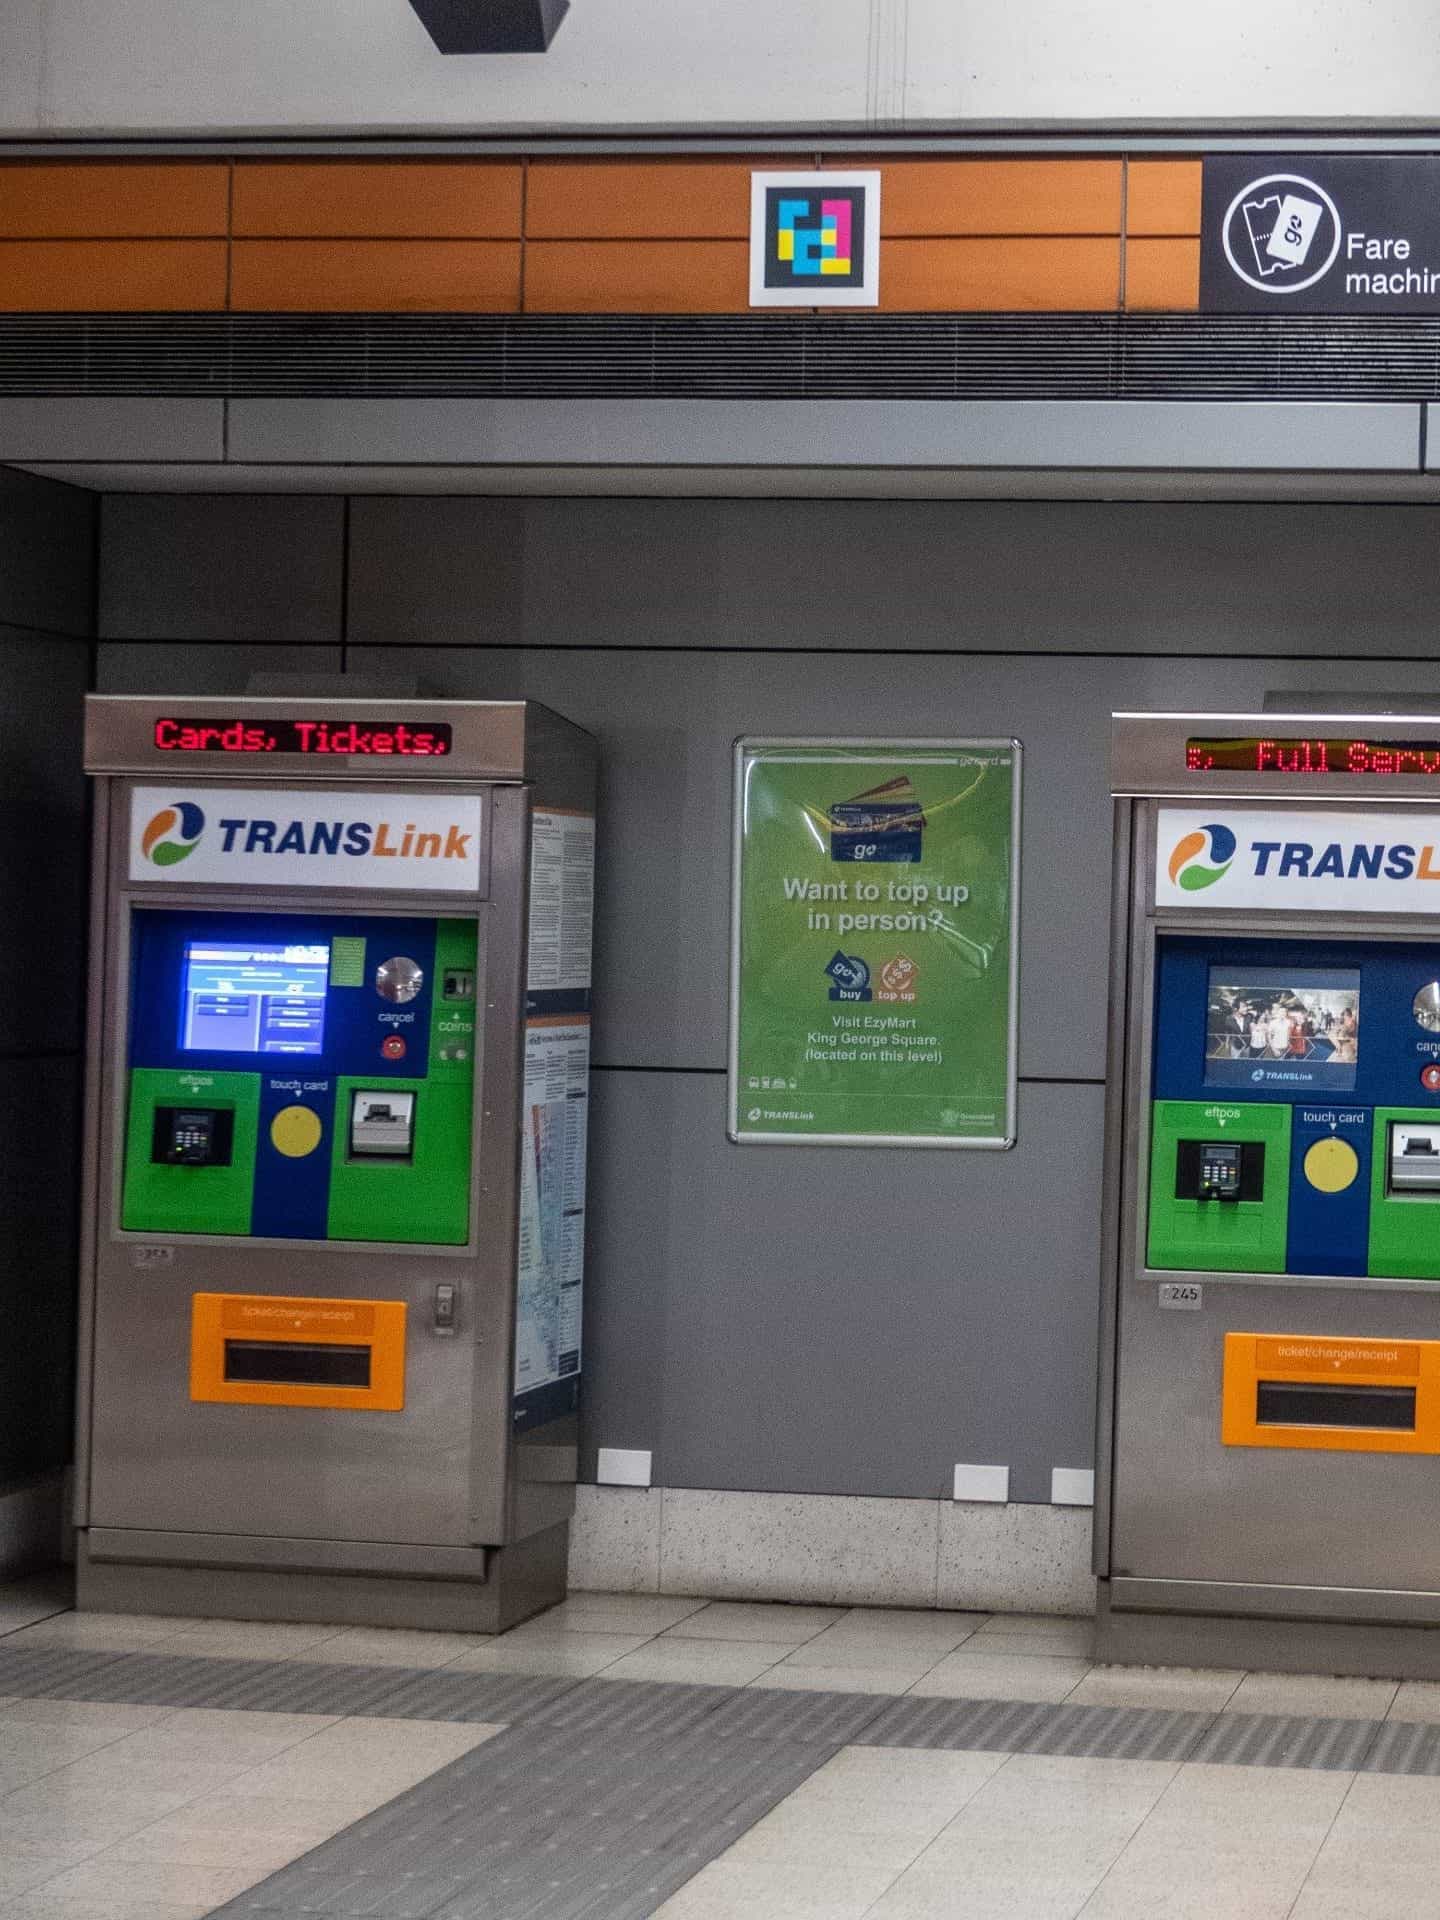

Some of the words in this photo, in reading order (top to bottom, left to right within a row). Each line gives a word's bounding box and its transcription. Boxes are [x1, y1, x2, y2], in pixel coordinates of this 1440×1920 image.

[1347, 233, 1410, 260] Fare
[1345, 267, 1440, 294] machin
[155, 719, 277, 751] Cards,
[294, 723, 447, 754] Tickets,
[1256, 741, 1329, 772] Full
[1347, 742, 1440, 773] Serv
[218, 818, 473, 859] TRANSLink
[854, 843, 877, 859] go
[1250, 841, 1440, 880] TRANSL
[783, 878, 847, 902] Want
[855, 880, 880, 901] to
[888, 880, 929, 906] top
[937, 884, 969, 907] up
[807, 908, 831, 930] in
[839, 990, 861, 1001] buy
[878, 990, 898, 1001] top
[900, 992, 916, 1002] up
[377, 1012, 416, 1023] cancel
[832, 1016, 861, 1028] Visit
[864, 1017, 917, 1031] EzyMart
[807, 1032, 838, 1046] King
[840, 1034, 888, 1047] George
[1416, 1042, 1440, 1053] can
[805, 1048, 857, 1061] (located
[860, 1051, 877, 1061] on
[880, 1050, 905, 1062] this
[908, 1051, 943, 1064] level)
[1265, 1070, 1313, 1082] TRANSLink
[271, 1079, 302, 1090] touch
[303, 1081, 329, 1091] card
[1204, 1107, 1241, 1120] eftpos
[1303, 1112, 1336, 1122] touch
[1338, 1113, 1365, 1124] card
